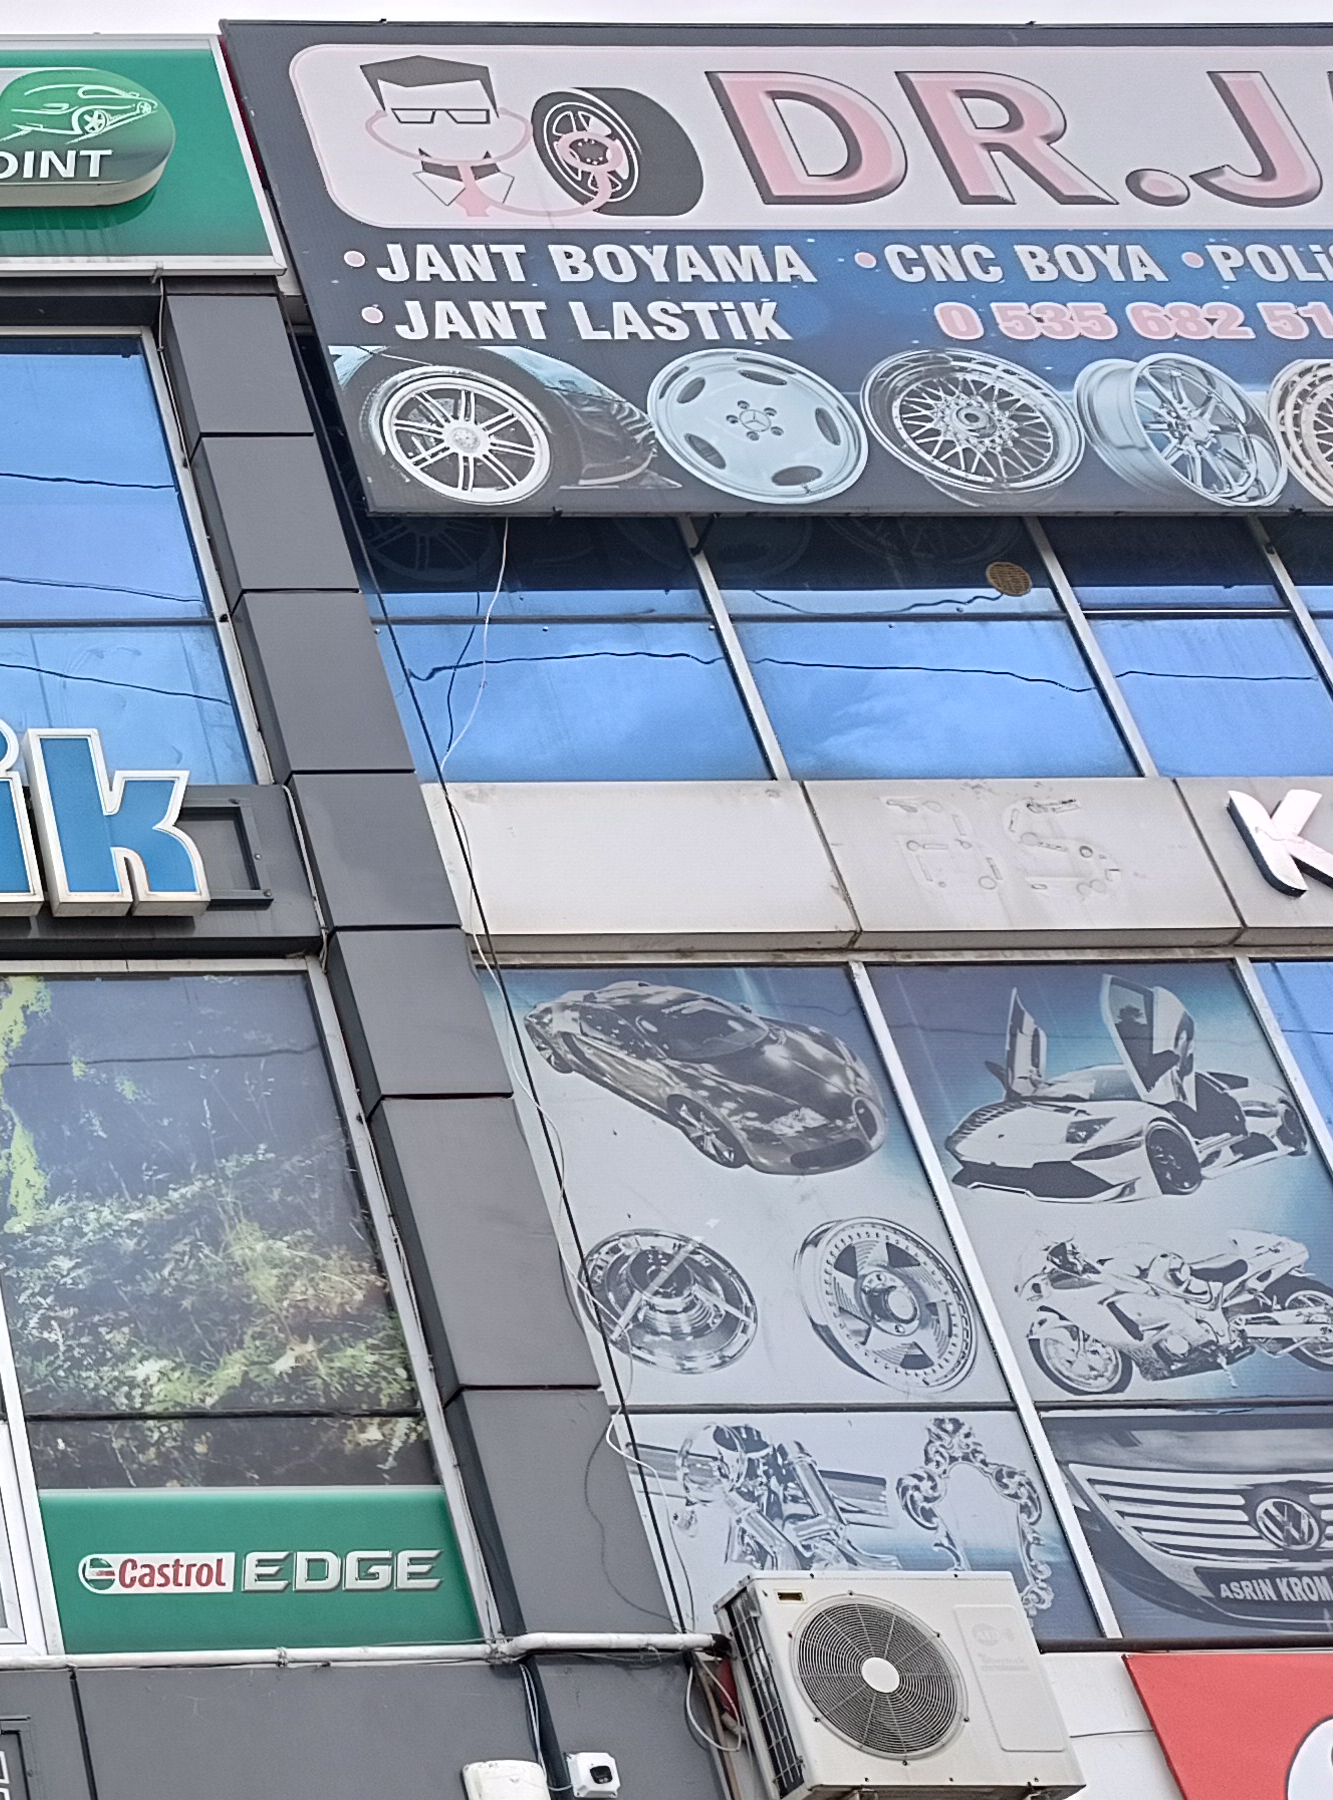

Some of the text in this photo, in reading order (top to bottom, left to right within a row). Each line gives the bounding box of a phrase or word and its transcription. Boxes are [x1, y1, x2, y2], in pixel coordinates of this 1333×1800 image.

[704, 70, 1333, 208] DR.J
[377, 243, 818, 283] JANT BOYAMA
[884, 243, 1169, 283] CNC BOYA
[394, 301, 547, 342] JANT
[933, 301, 986, 341] 0
[989, 301, 1119, 341] 535
[1126, 301, 1257, 341] 682
[118, 1549, 443, 1593] Castrol EDGE
[1219, 1575, 1333, 1602] ASRIN KROM
